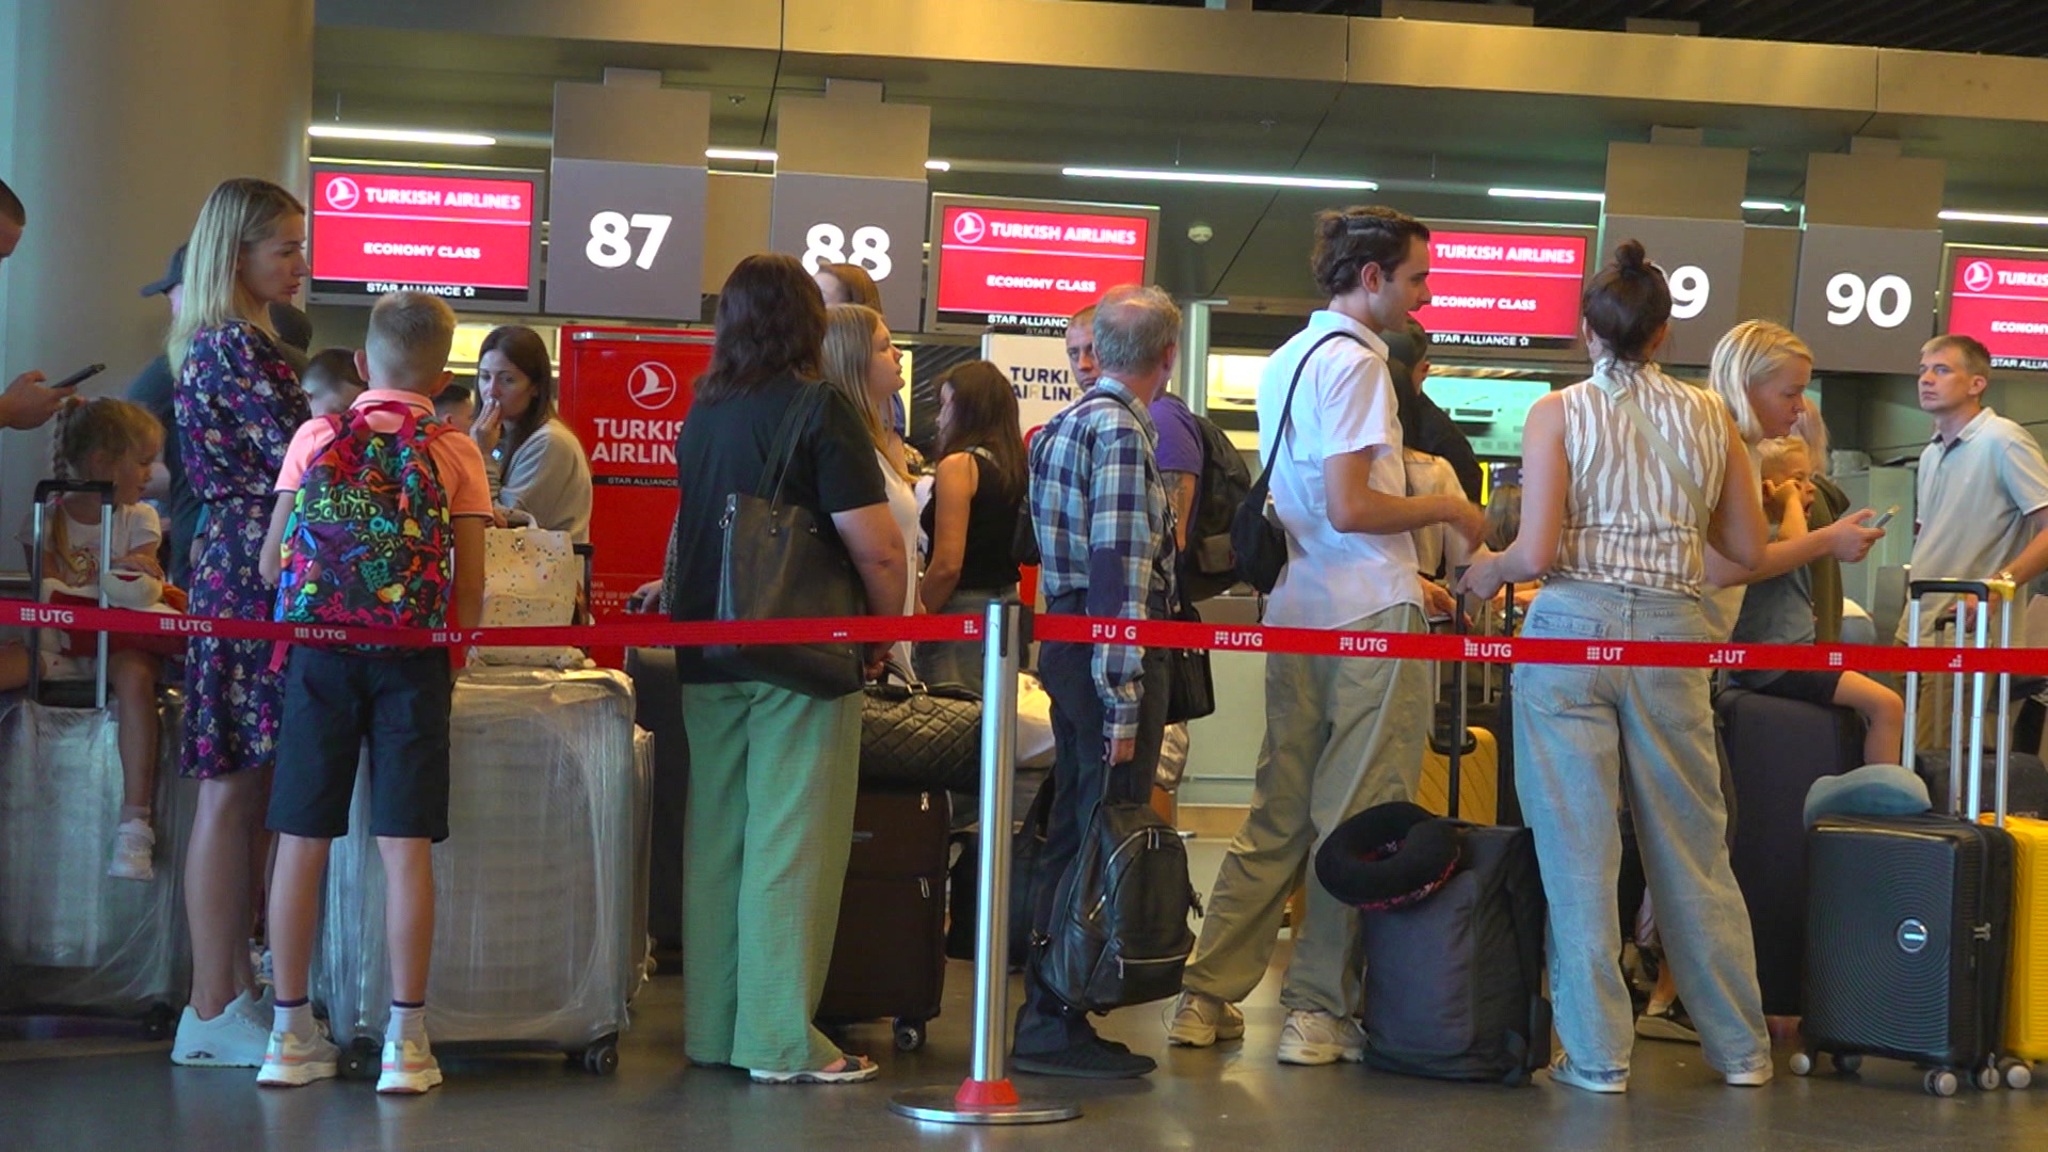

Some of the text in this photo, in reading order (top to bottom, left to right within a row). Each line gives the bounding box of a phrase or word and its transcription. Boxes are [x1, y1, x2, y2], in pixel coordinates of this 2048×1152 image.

[364, 187, 521, 210] TURKISH AIRLINES
[585, 210, 673, 270] 87
[990, 221, 1136, 245] TURKISH AIRLINES
[363, 242, 481, 260] ECONOMY CLASS
[801, 223, 892, 282] 88
[1435, 243, 1575, 264] TURKISH AIRLINES
[986, 275, 1097, 294] ECONOMY CLASS
[1997, 271, 2048, 287] TURKIS
[366, 282, 399, 293] STAR
[1653, 263, 1710, 319] 9
[1431, 295, 1537, 312] ECONOMY CLASS
[1825, 272, 1912, 329] 90
[987, 314, 1069, 328] STAR ALLIANC
[1431, 333, 1517, 346] STAR ALLIANCE
[1991, 357, 2048, 370] STAR ALLIA
[591, 443, 677, 464] AIRLIN
[607, 476, 679, 487] STAR ALLIANCE
[305, 498, 383, 524] SQUAD
[38, 609, 75, 624] UTG
[177, 620, 213, 633] UTG
[312, 627, 348, 641] UTG
[1231, 632, 1264, 647] UTG
[1356, 637, 1388, 653] UTG
[1480, 642, 1512, 658] UTG
